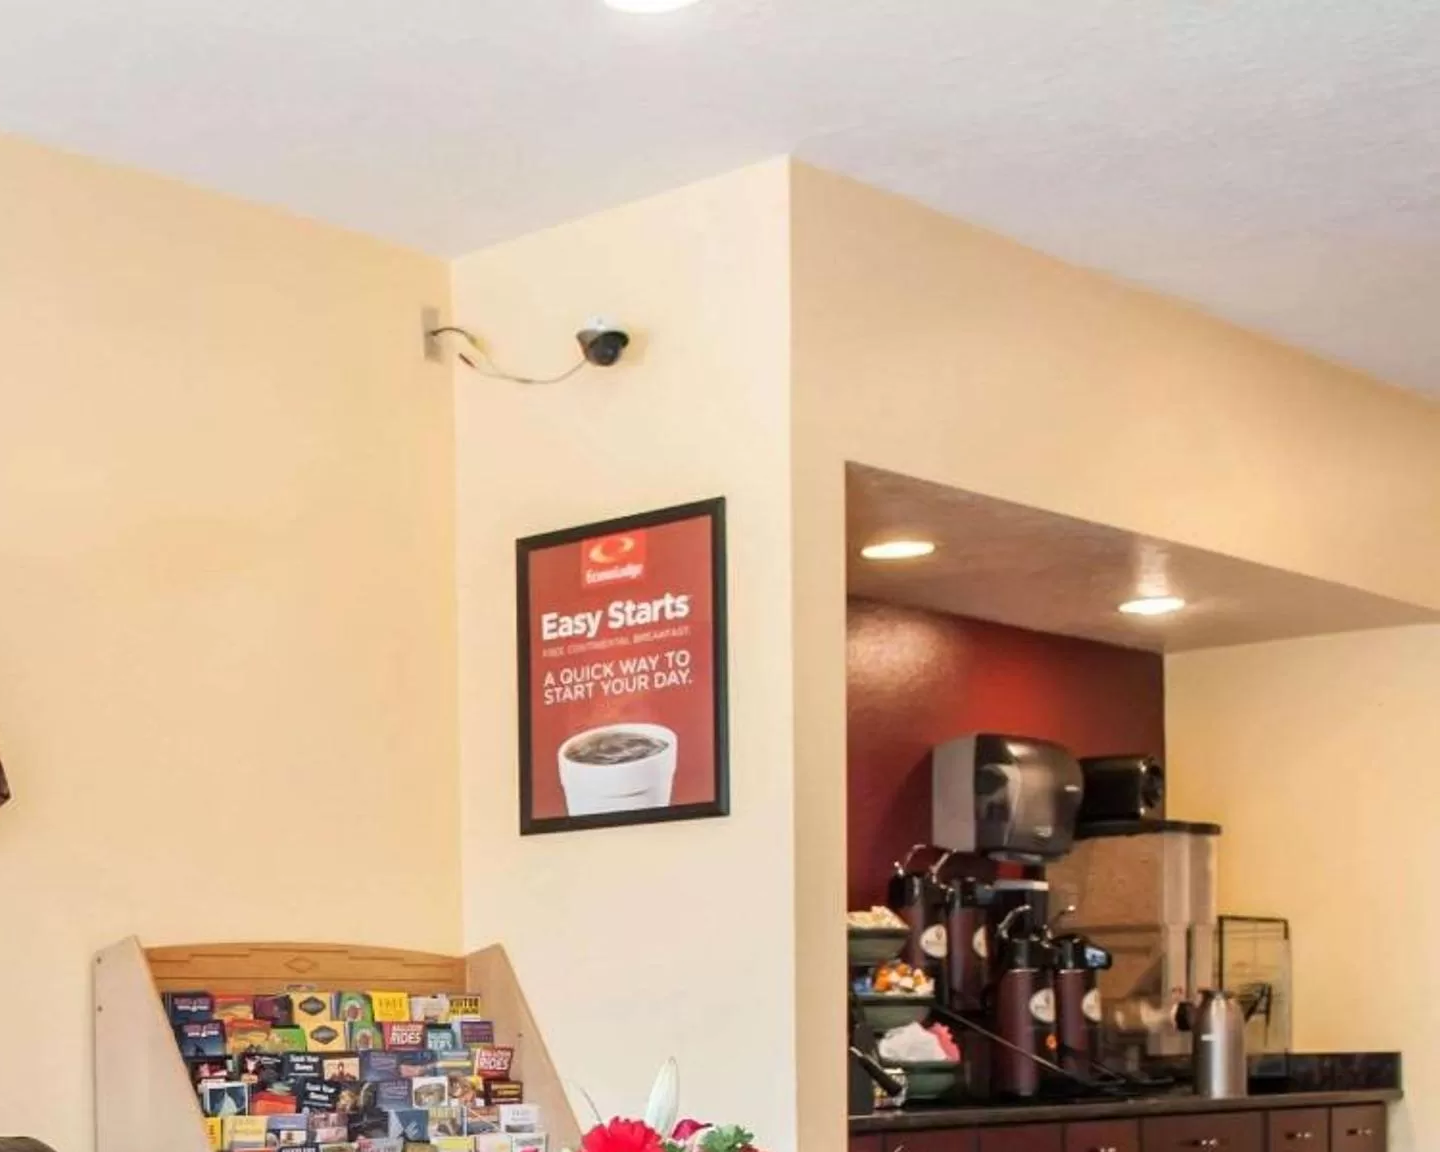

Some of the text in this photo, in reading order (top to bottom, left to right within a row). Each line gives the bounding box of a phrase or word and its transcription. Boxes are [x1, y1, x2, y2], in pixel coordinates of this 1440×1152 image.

[541, 592, 691, 641] Easy Starts
[543, 649, 691, 687] A QUICK WAY TO
[543, 667, 694, 706] START YOUR DAY.
